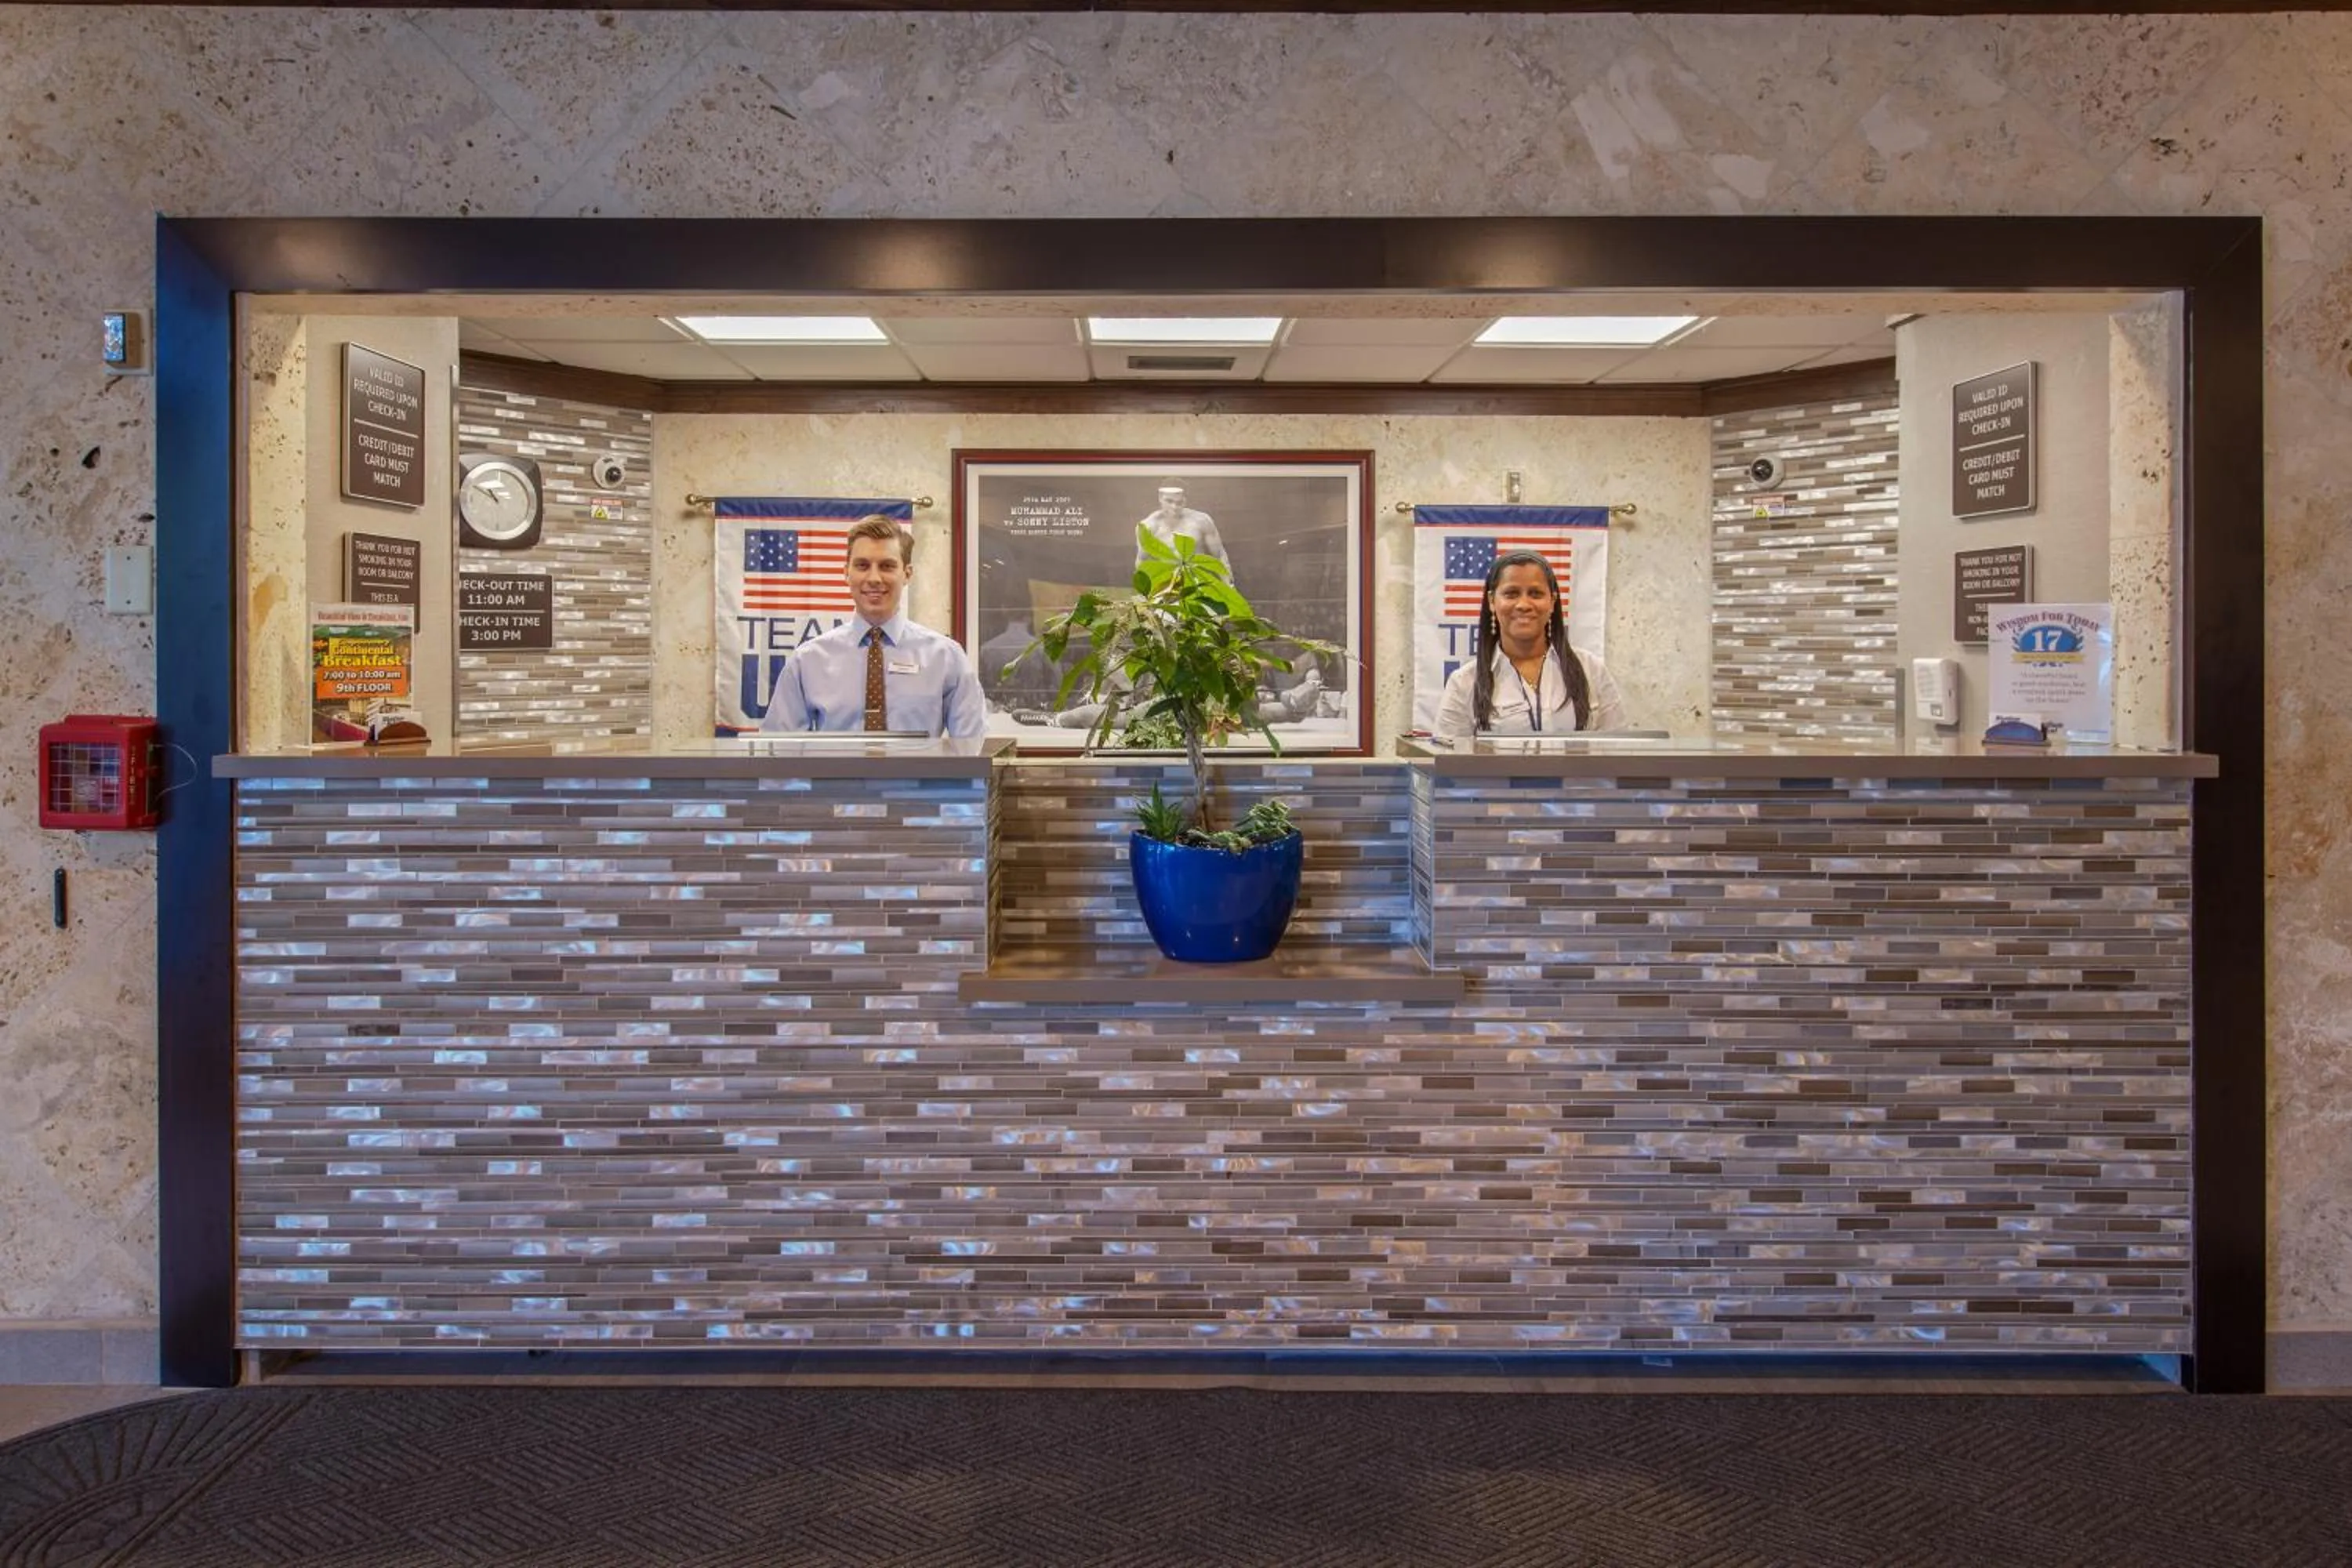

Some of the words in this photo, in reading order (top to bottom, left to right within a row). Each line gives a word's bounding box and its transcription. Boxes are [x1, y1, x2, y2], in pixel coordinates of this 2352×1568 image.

[369, 366, 393, 383] VALID
[354, 379, 395, 401] REQUIRED
[396, 394, 418, 408] UPON
[1972, 388, 1997, 403] VALID
[1998, 384, 2008, 397] ID
[368, 401, 407, 420] CHECK-IN
[1958, 403, 1998, 423] REQUIRED
[2000, 396, 2024, 412] UPON
[1972, 416, 2011, 435] CHECK-IN
[358, 434, 415, 458] CREDIT/DEBIT
[365, 453, 387, 468] CARD
[388, 457, 409, 473] MUST
[1962, 449, 2020, 470] CREDIT/DEBIT
[373, 472, 401, 488] MATCH
[1969, 472, 1990, 485] CARD
[1991, 466, 2015, 481] MUST
[1976, 485, 2005, 499] MATCH
[1017, 517, 1048, 526] SONNY
[1052, 517, 1089, 526] LISTON
[517, 581, 545, 591] TIME
[467, 594, 503, 604] 11:00
[506, 594, 525, 605] AM
[459, 616, 509, 626] HECK-IN
[513, 616, 540, 626] TIME
[471, 630, 499, 641] 3:00
[503, 630, 521, 641] PM
[737, 615, 843, 650] TEA
[2032, 630, 2063, 652] 17
[332, 644, 394, 655] Continental
[323, 655, 402, 666] Breakfast
[323, 670, 345, 680] 7:00
[346, 670, 357, 679] to
[359, 670, 385, 679] 10:00
[336, 683, 355, 693] 9th
[356, 683, 392, 692] FLOOR
